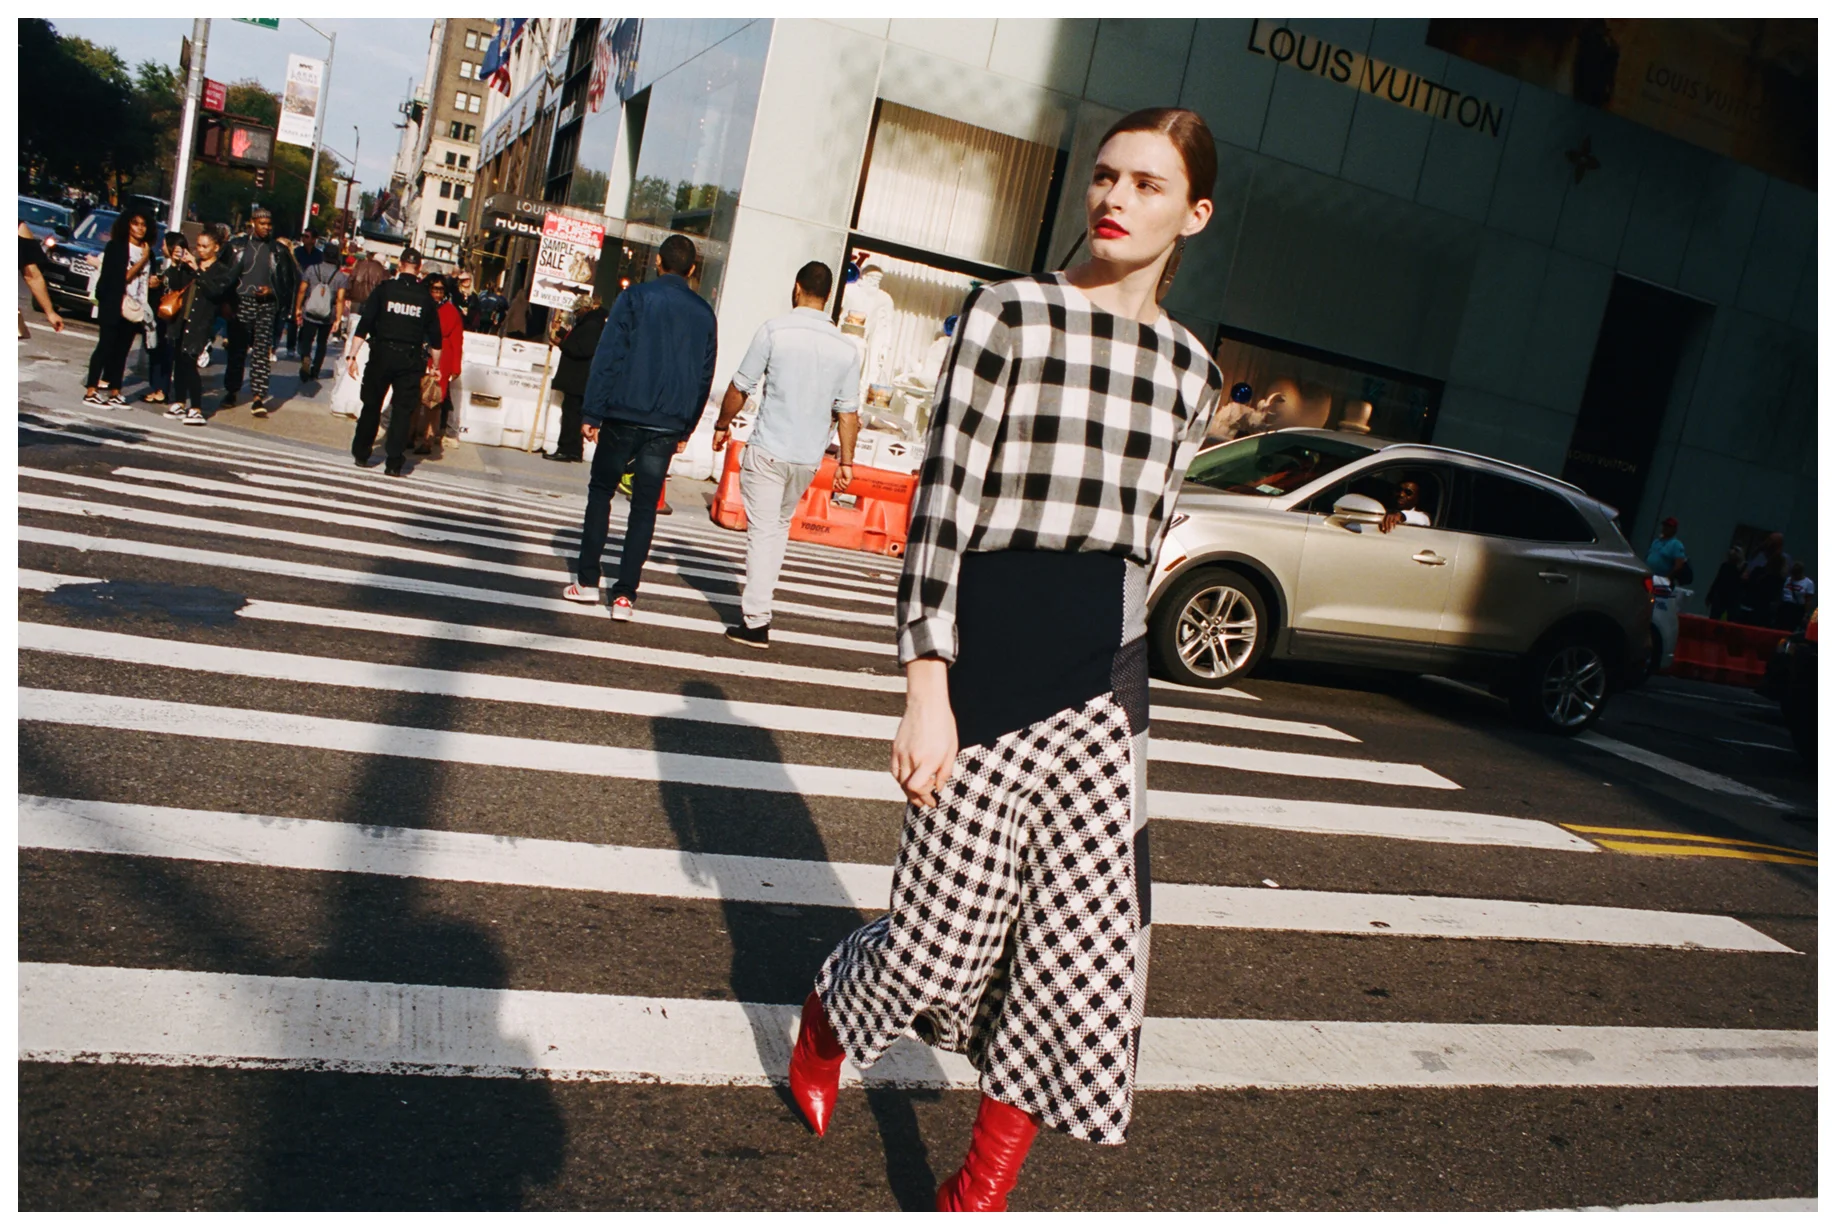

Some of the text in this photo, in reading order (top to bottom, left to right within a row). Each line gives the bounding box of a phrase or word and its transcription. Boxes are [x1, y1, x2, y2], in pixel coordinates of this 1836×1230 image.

[1247, 18, 1504, 138] LOUIS VUITTON
[1645, 62, 1702, 100] LOUIS
[557, 220, 592, 238] FURS
[542, 237, 575, 256] SAMPLE
[539, 249, 565, 271] SALE
[541, 292, 560, 302] WEST
[387, 301, 422, 318] POLICE
[801, 520, 830, 534] YODOCK
